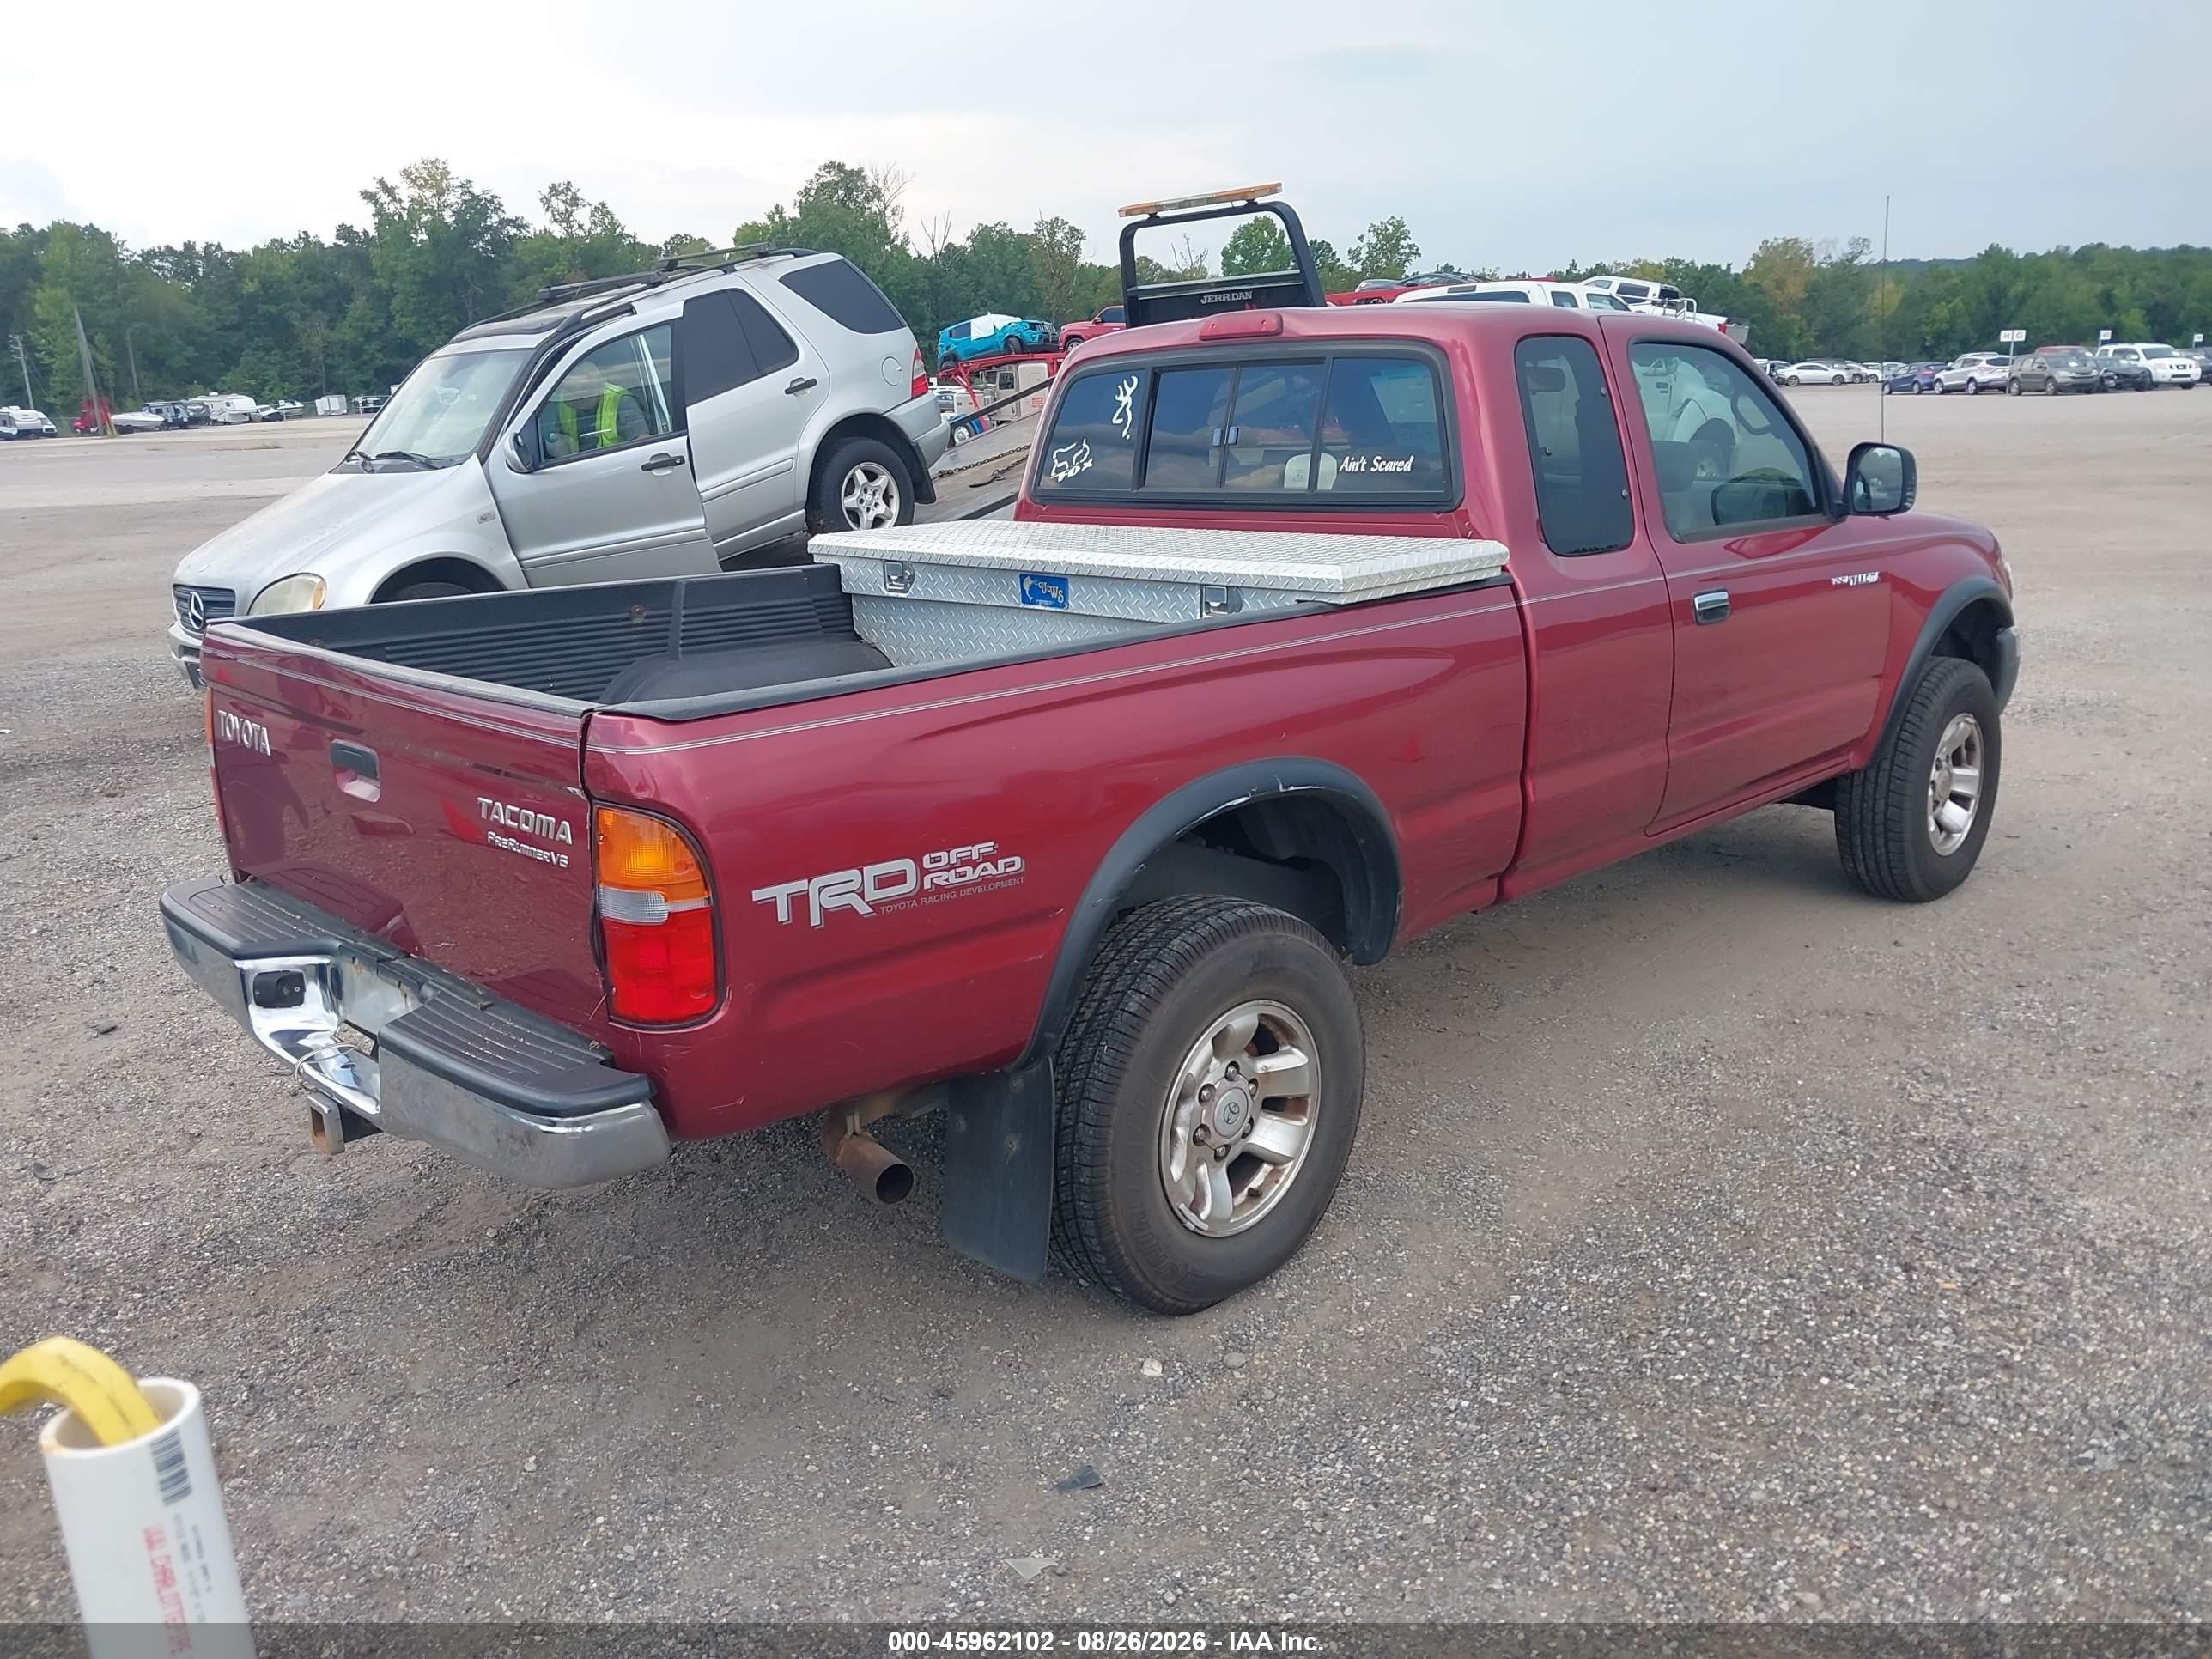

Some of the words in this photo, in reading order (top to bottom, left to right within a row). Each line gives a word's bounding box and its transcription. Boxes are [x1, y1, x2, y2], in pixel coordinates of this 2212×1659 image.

[1339, 455, 1368, 472] Ain't
[1370, 454, 1415, 472] Scared
[218, 709, 271, 757] TOYOTA
[477, 797, 573, 845] TACOMA
[922, 841, 998, 870] OFF
[923, 856, 1025, 890] ROAD
[751, 859, 921, 927] TRD
[880, 901, 918, 915] TOYOTA
[921, 891, 957, 907] RACING
[960, 877, 1025, 897] DEVELOPMENT
